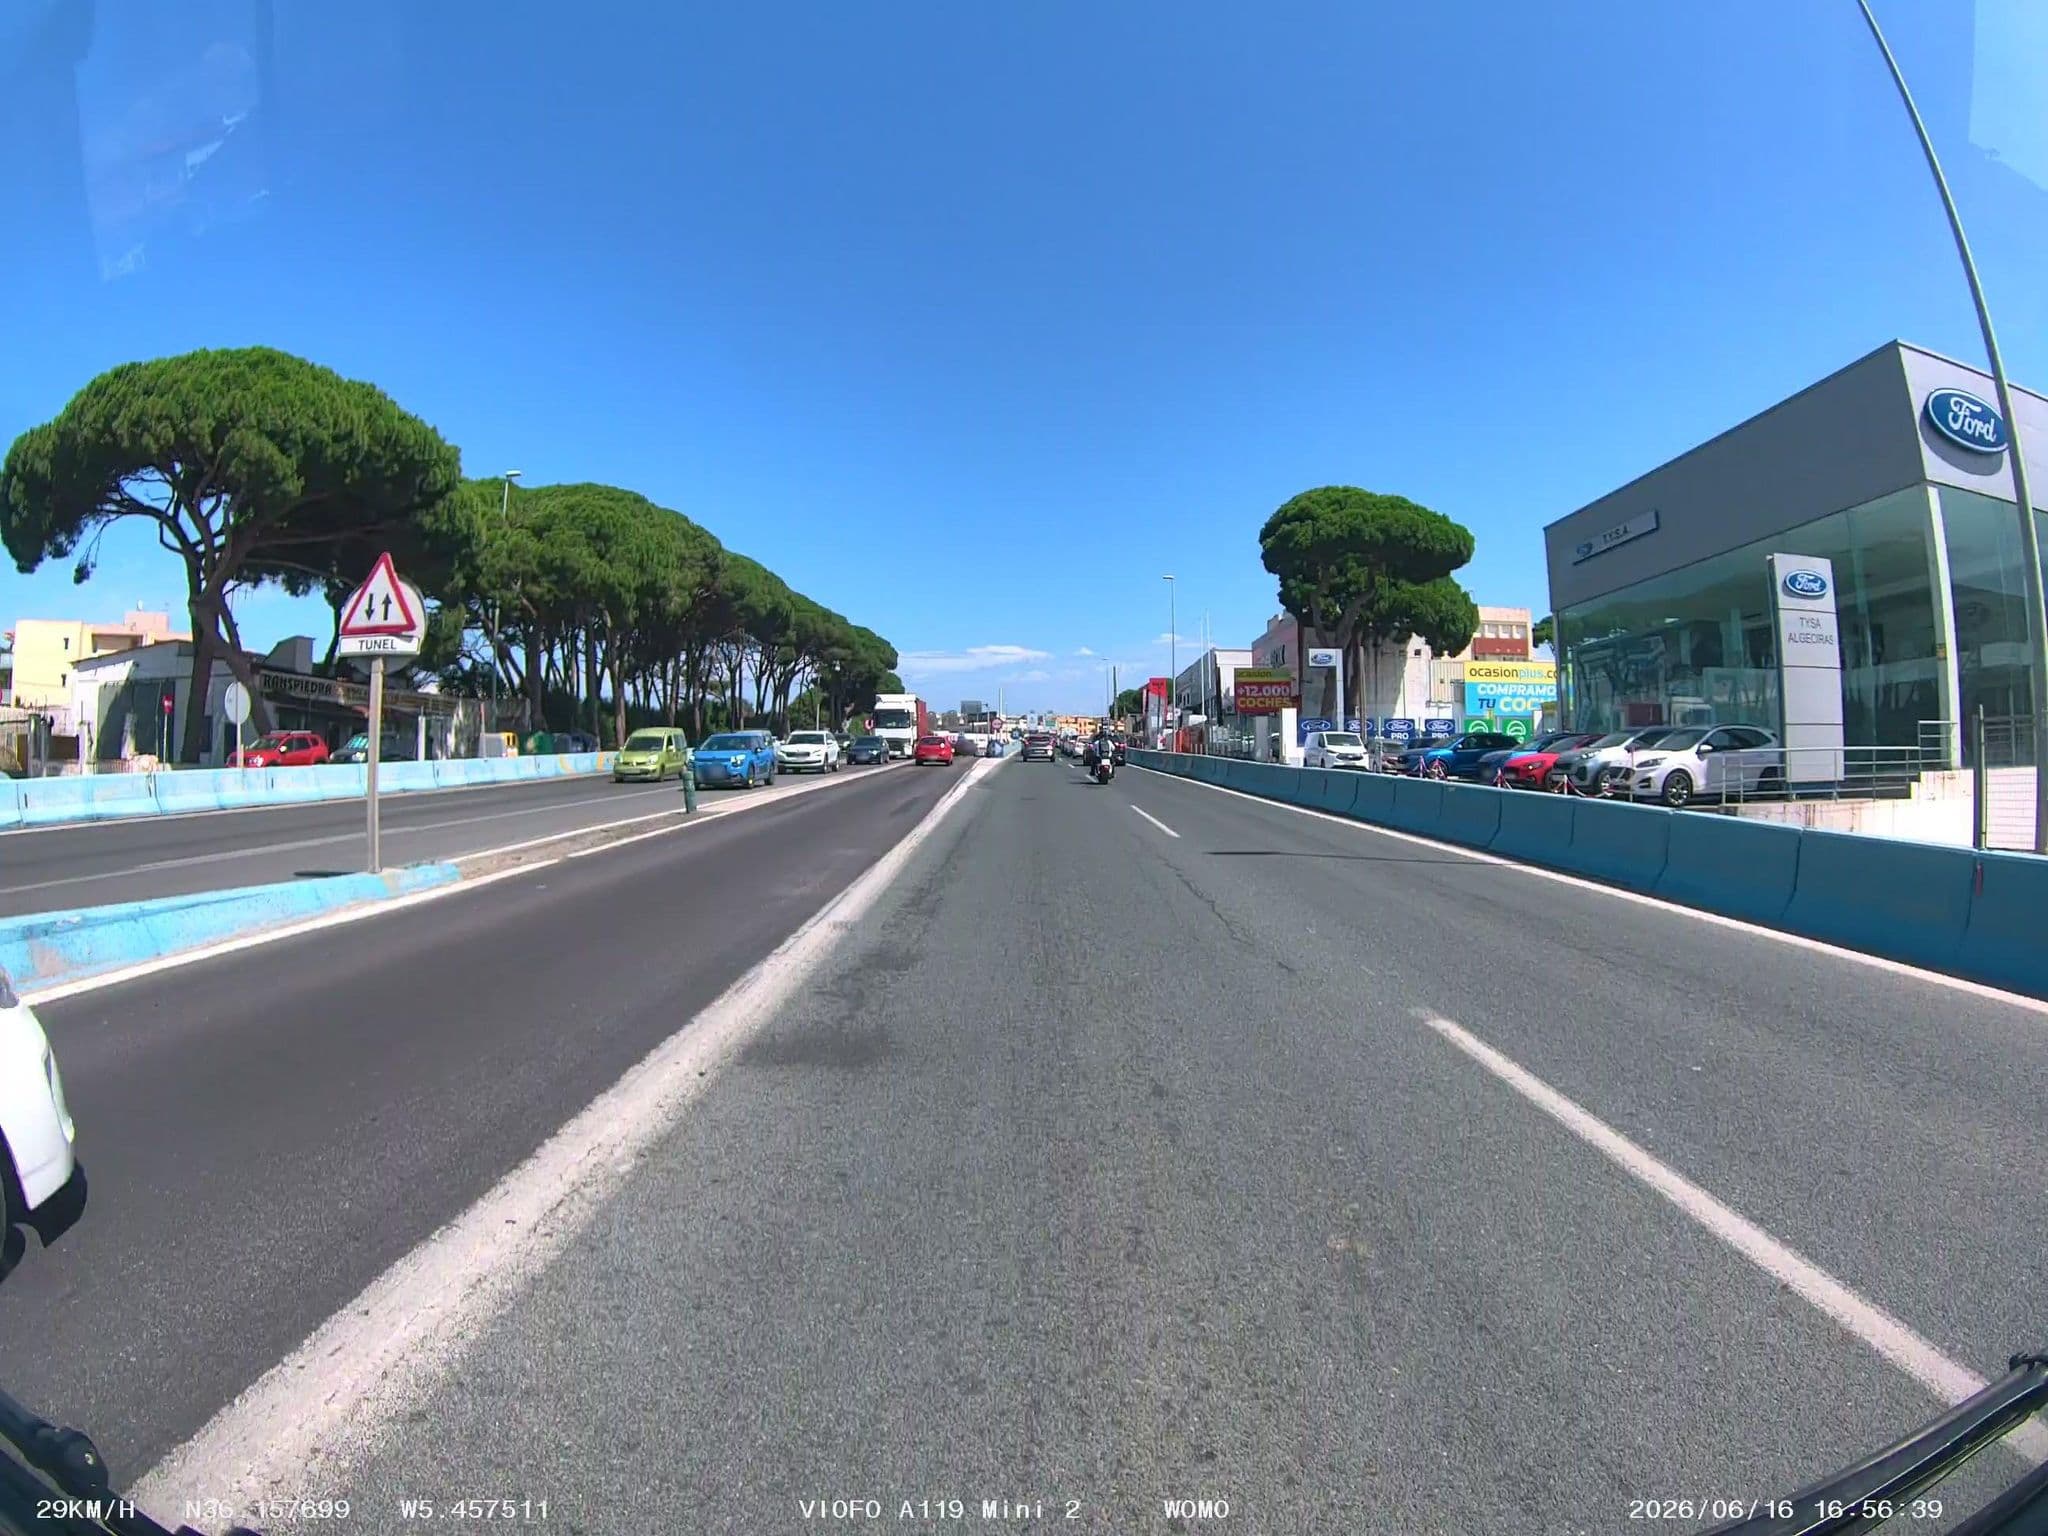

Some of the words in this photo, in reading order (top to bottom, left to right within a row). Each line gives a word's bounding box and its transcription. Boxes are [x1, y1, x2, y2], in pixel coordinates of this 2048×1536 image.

[1947, 397, 1997, 442] Ford
[1795, 574, 1823, 592] Ford
[1799, 617, 1822, 629] TYSA
[358, 639, 398, 651] TUNEL
[1787, 632, 1834, 646] ALGECIRAS
[1469, 667, 1558, 679] ocasionplus.co
[1237, 684, 1290, 697] +12.000
[1477, 683, 1557, 697] COMPRAMO
[1238, 696, 1293, 708] COCHES
[1478, 698, 1496, 709] TU
[1391, 732, 1409, 740] PRO
